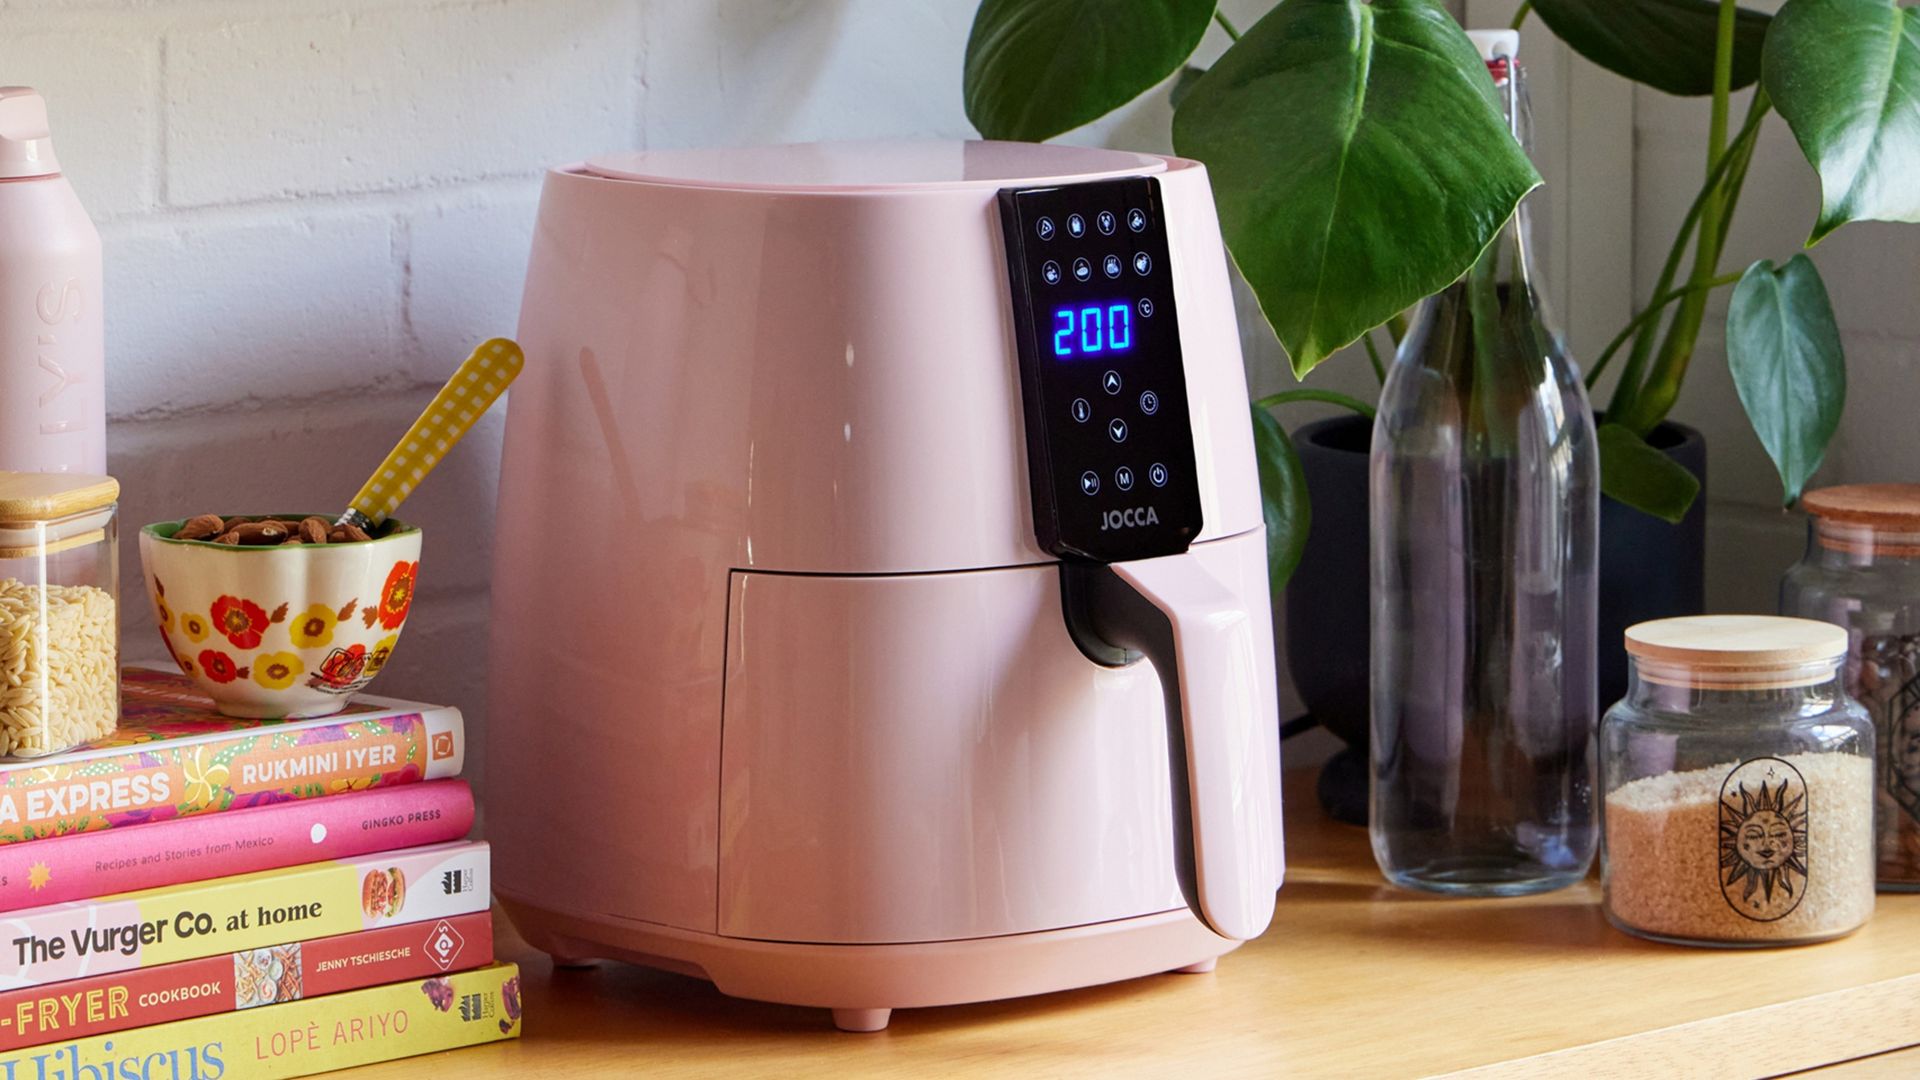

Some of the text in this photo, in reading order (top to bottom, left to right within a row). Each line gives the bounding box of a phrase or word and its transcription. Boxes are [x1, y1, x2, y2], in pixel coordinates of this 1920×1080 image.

[1054, 305, 1130, 356] 200
[1119, 472, 1130, 485] M
[1100, 506, 1160, 531] JOCCA
[27, 772, 170, 821] EXPRESS
[242, 752, 339, 785] RUKMINI
[345, 744, 397, 772] IYER
[95, 855, 137, 872] Recipes
[141, 853, 161, 866] and
[165, 848, 202, 862] Stories
[205, 842, 232, 857] from
[235, 836, 275, 851] Mexico
[361, 813, 404, 831] GINGKO
[408, 809, 441, 825] PRESS
[12, 900, 323, 967] The Vurger Co. at home
[138, 981, 222, 1008] COOKBOOK
[316, 956, 349, 973] JENNY
[350, 947, 411, 968] TSCHIESCHE
[256, 1020, 321, 1061] LOPÈ
[333, 1009, 410, 1046] ARIYO
